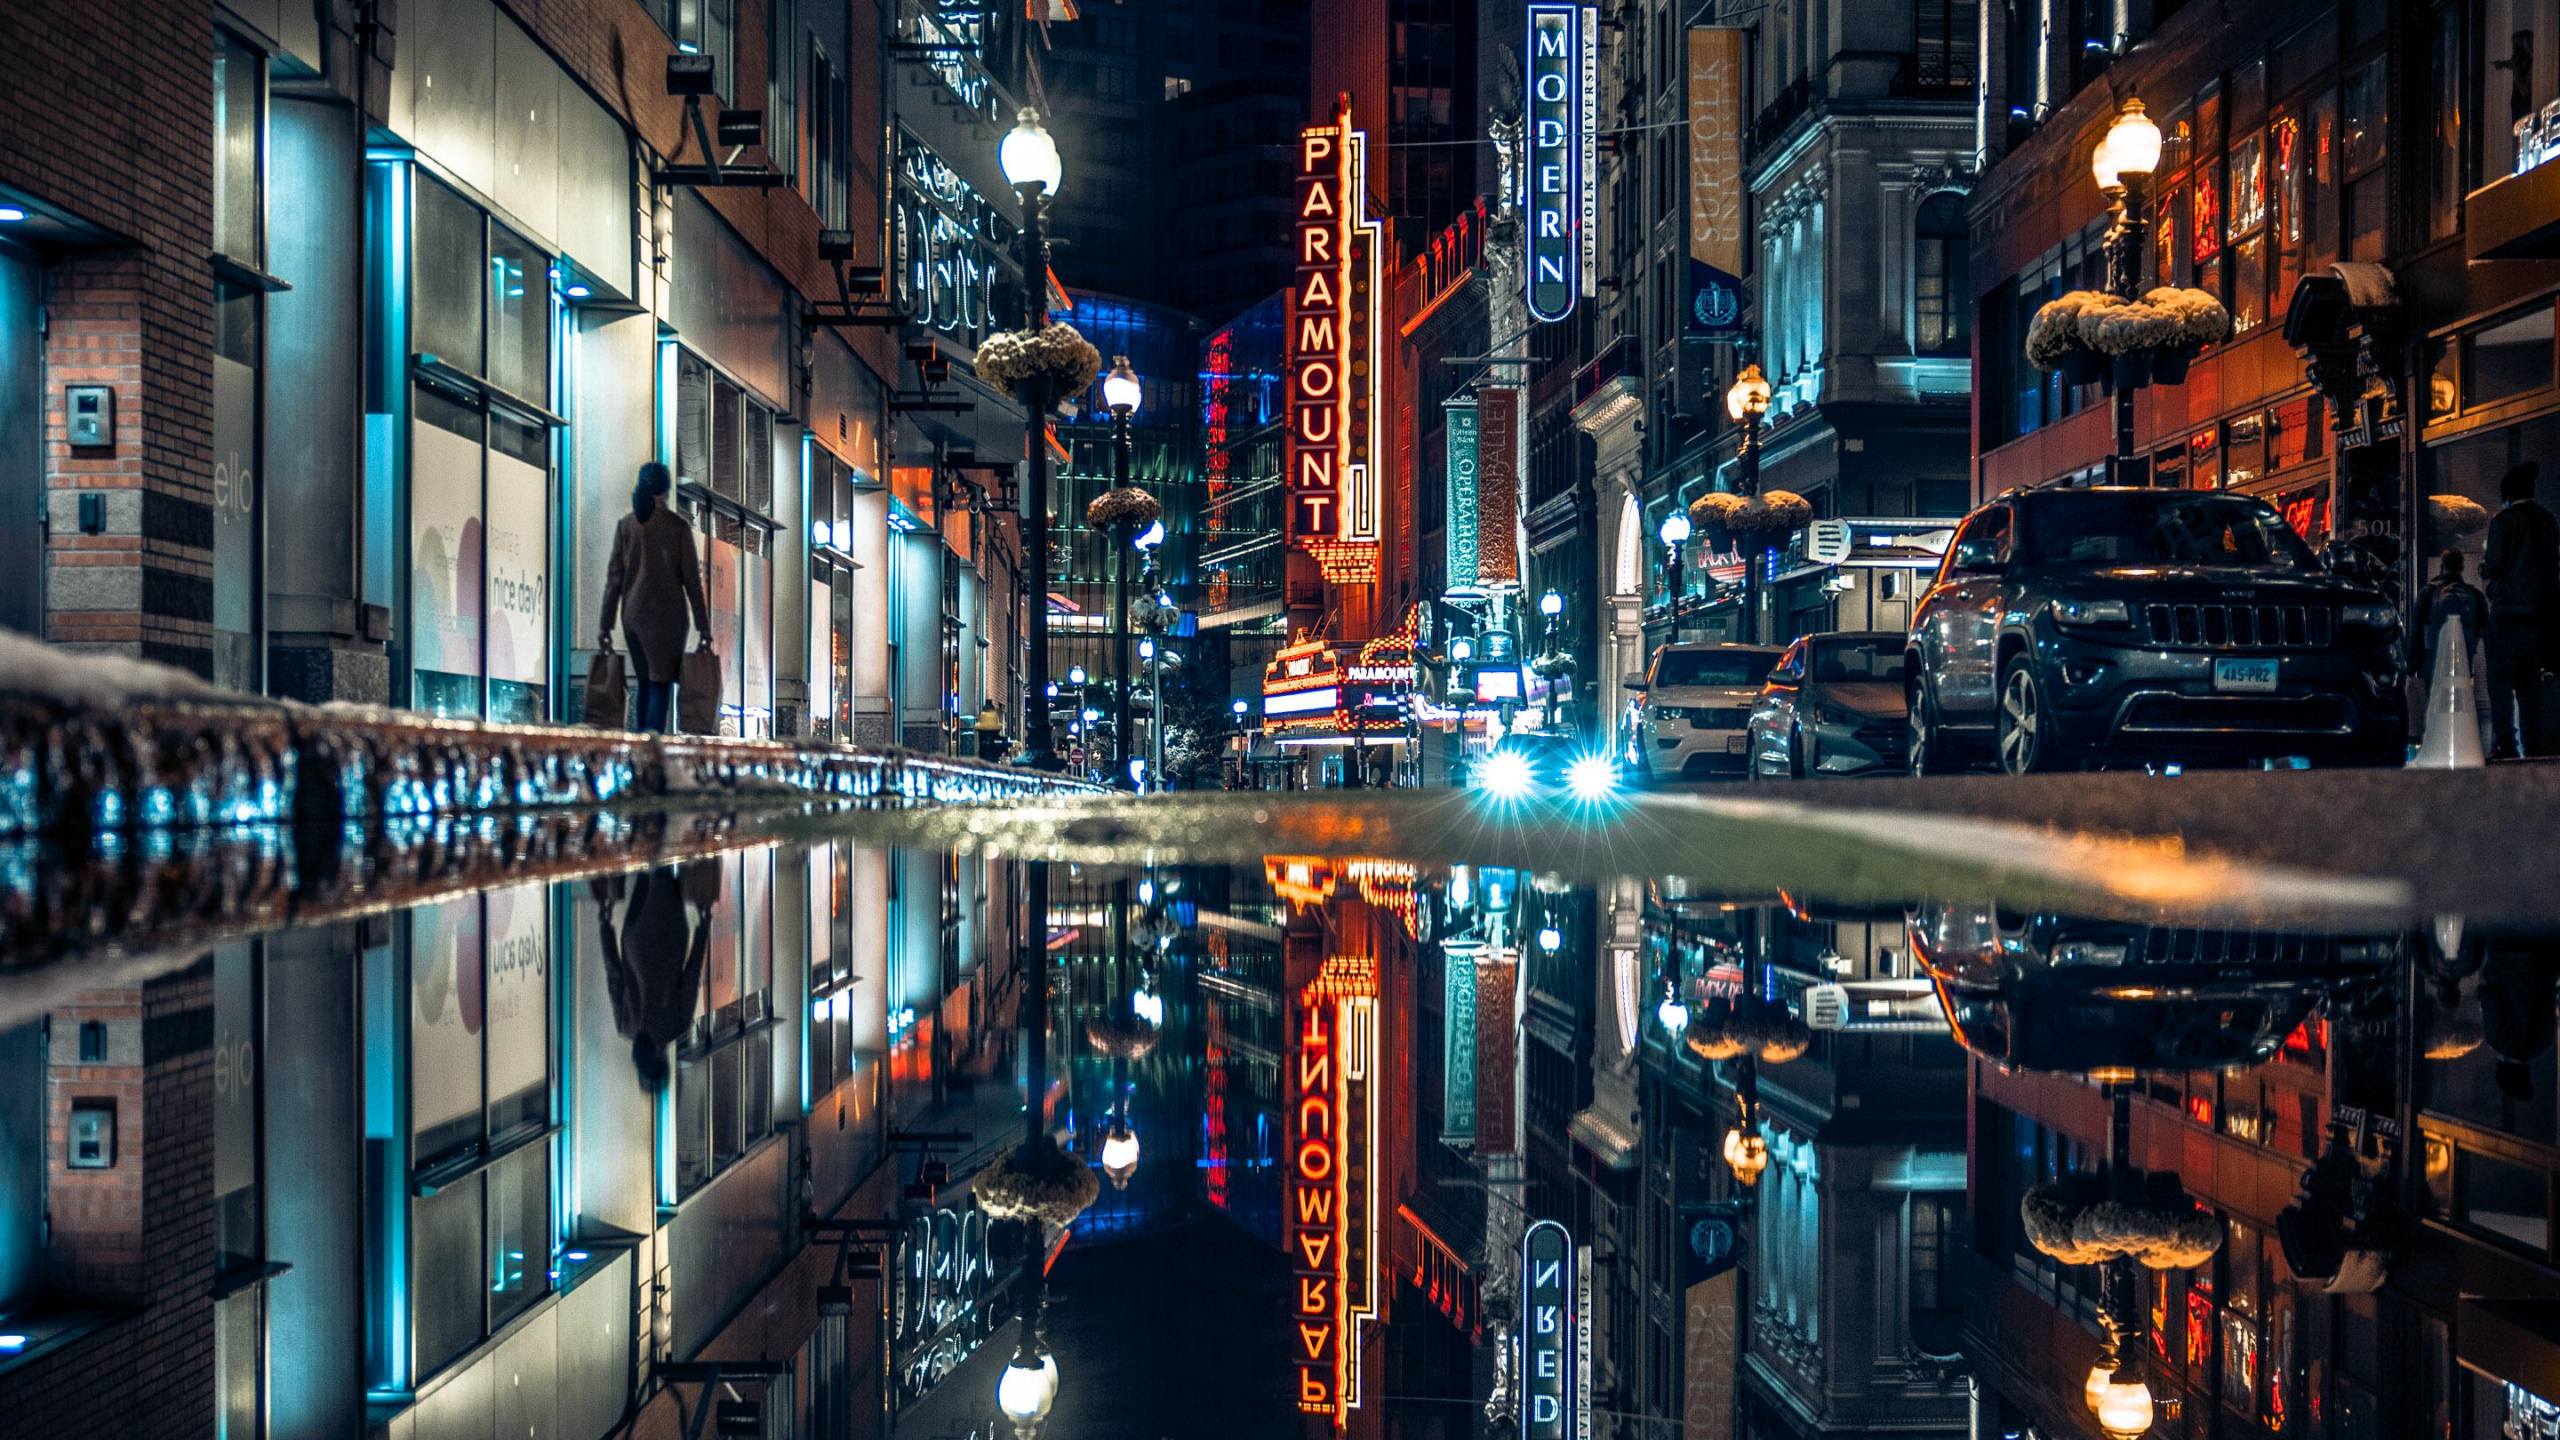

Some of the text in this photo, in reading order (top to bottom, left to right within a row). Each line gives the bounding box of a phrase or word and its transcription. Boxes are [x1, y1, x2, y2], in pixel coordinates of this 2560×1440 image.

[1537, 30, 1567, 283] MODERN
[1584, 41, 1593, 268] SUFFOLK UNIVERSITY
[1693, 59, 1721, 243] SUFFOLK
[1721, 60, 1739, 243] UNIVERSITY
[1300, 138, 1334, 531] PARAMOUNT
[493, 567, 543, 626] nice day?
[1457, 458, 1475, 588] OPERA HOUSE
[2357, 518, 2391, 538] 501
[1348, 667, 1414, 681] PARAMOUNT
[1687, 618, 1711, 629] WEST
